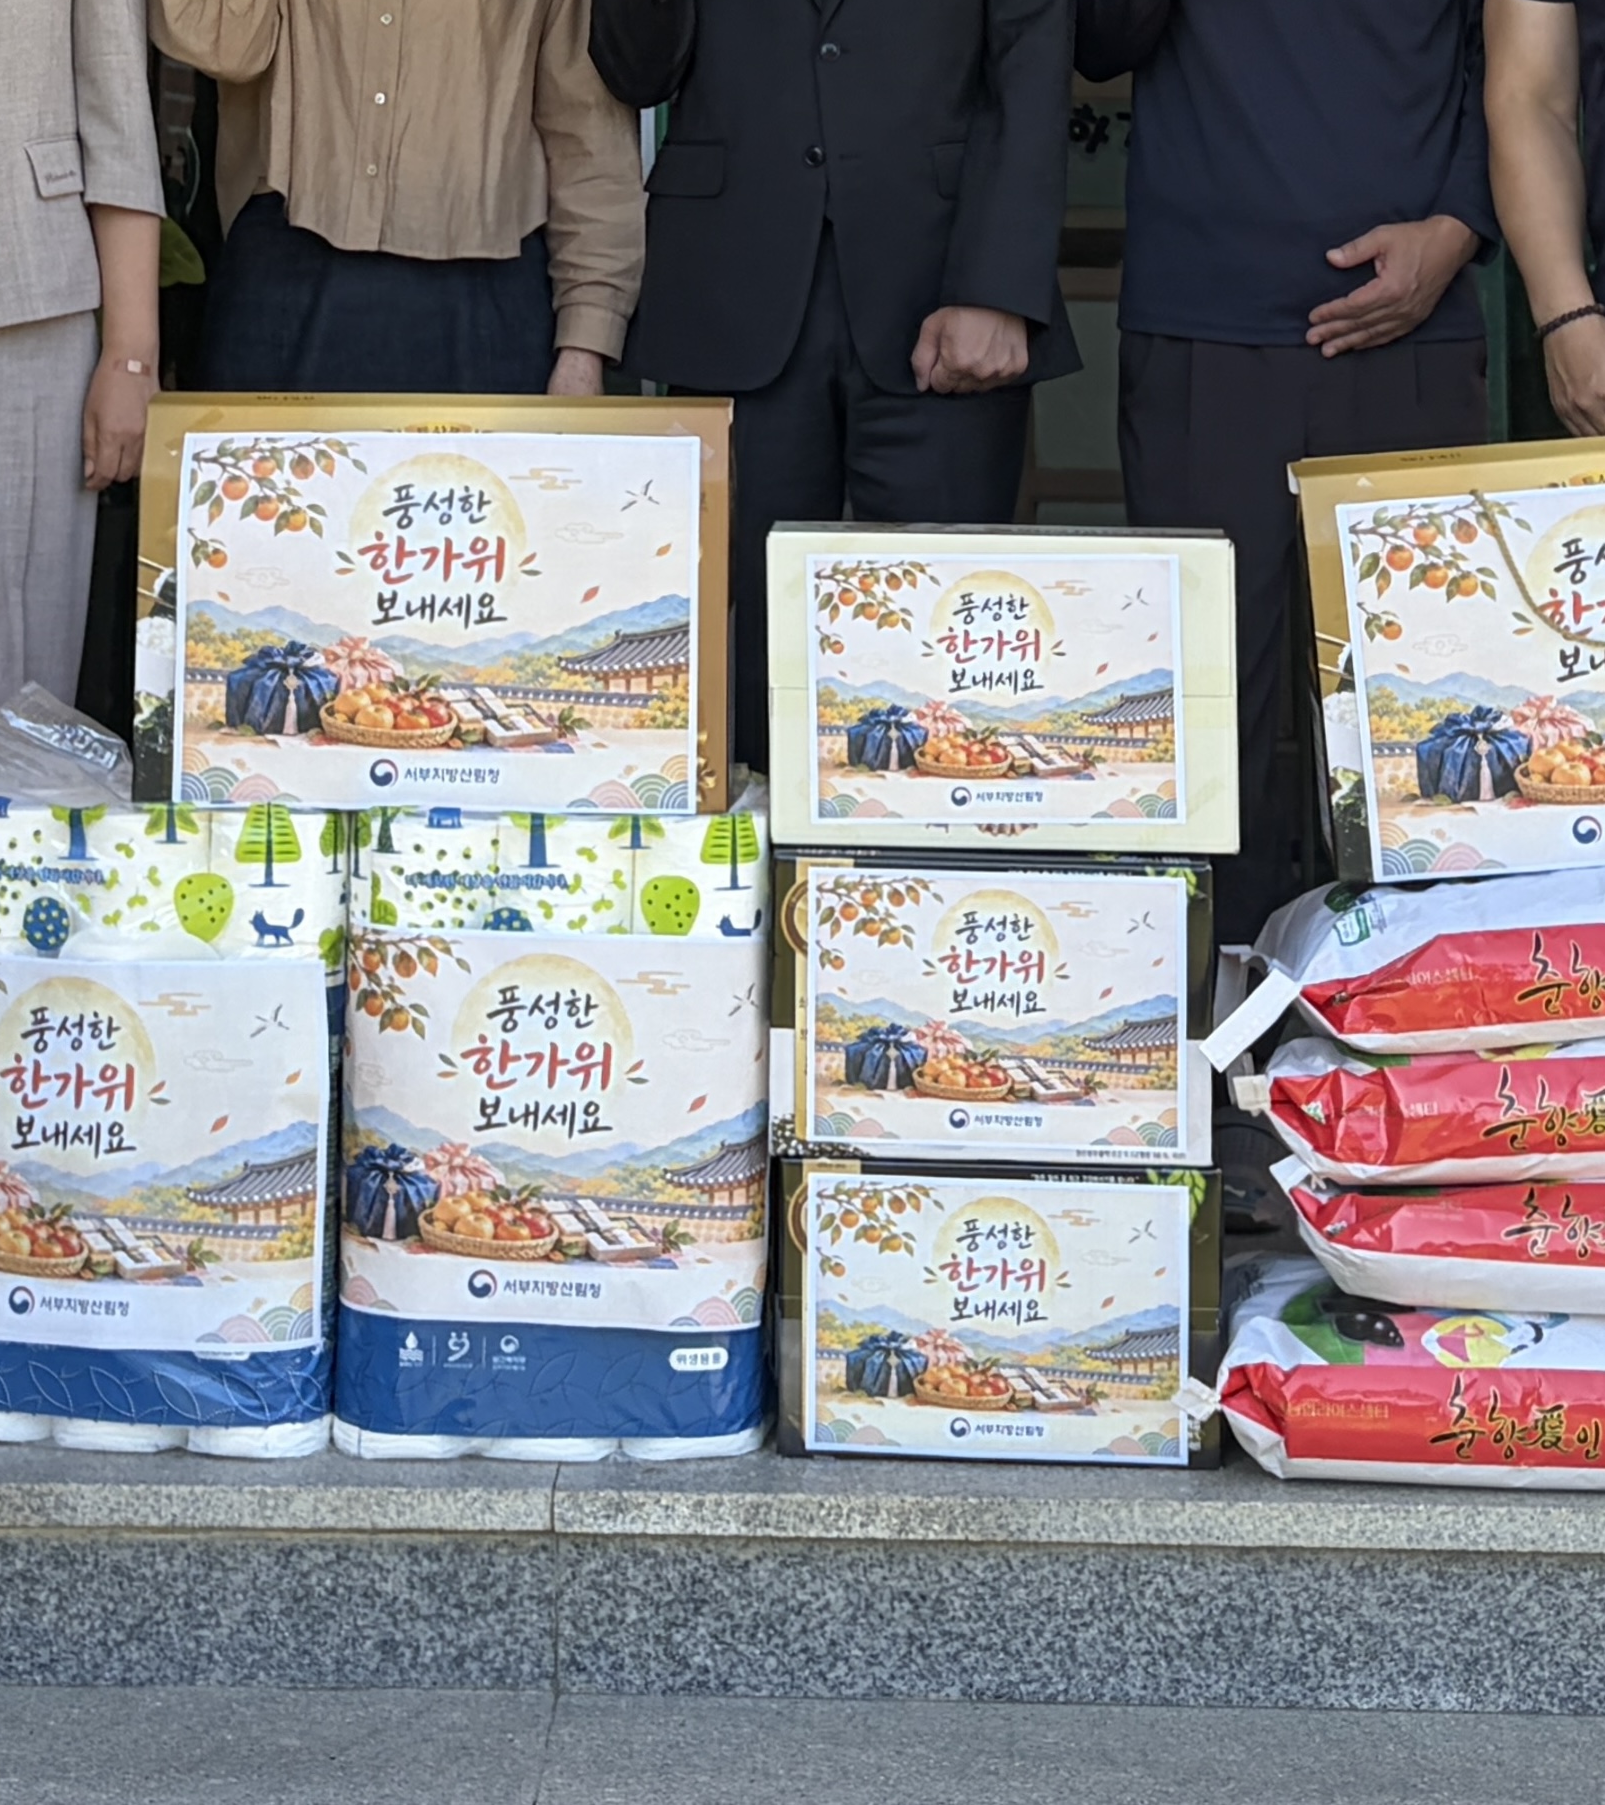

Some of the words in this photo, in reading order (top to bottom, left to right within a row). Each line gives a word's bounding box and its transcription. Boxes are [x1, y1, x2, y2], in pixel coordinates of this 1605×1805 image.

[381, 483, 492, 528] 풍성한
[357, 531, 506, 585] 한가위
[371, 590, 508, 629] 보내세요
[951, 592, 1030, 625] 풍성한
[937, 626, 1042, 664] 한가위
[948, 667, 1045, 696] 보내세요
[404, 765, 500, 786] 서부지방산림청
[954, 910, 1035, 945] 풍성한
[938, 944, 1046, 985] 한가위
[485, 983, 599, 1034] 풍성한
[948, 989, 1047, 1018] 보내세요
[19, 1005, 122, 1055] 풍성한
[460, 1033, 613, 1095] 한가위
[0, 1060, 136, 1111] 한가위
[10, 1114, 137, 1159] 보내세요
[472, 1095, 613, 1140] 보내세요
[955, 1217, 1036, 1253] 풍성한
[502, 1276, 603, 1299] 서부지방산림청
[938, 1252, 1047, 1294] 한가위
[39, 1294, 130, 1318] 서부지방산림청
[949, 1296, 1048, 1326] 보내세요
